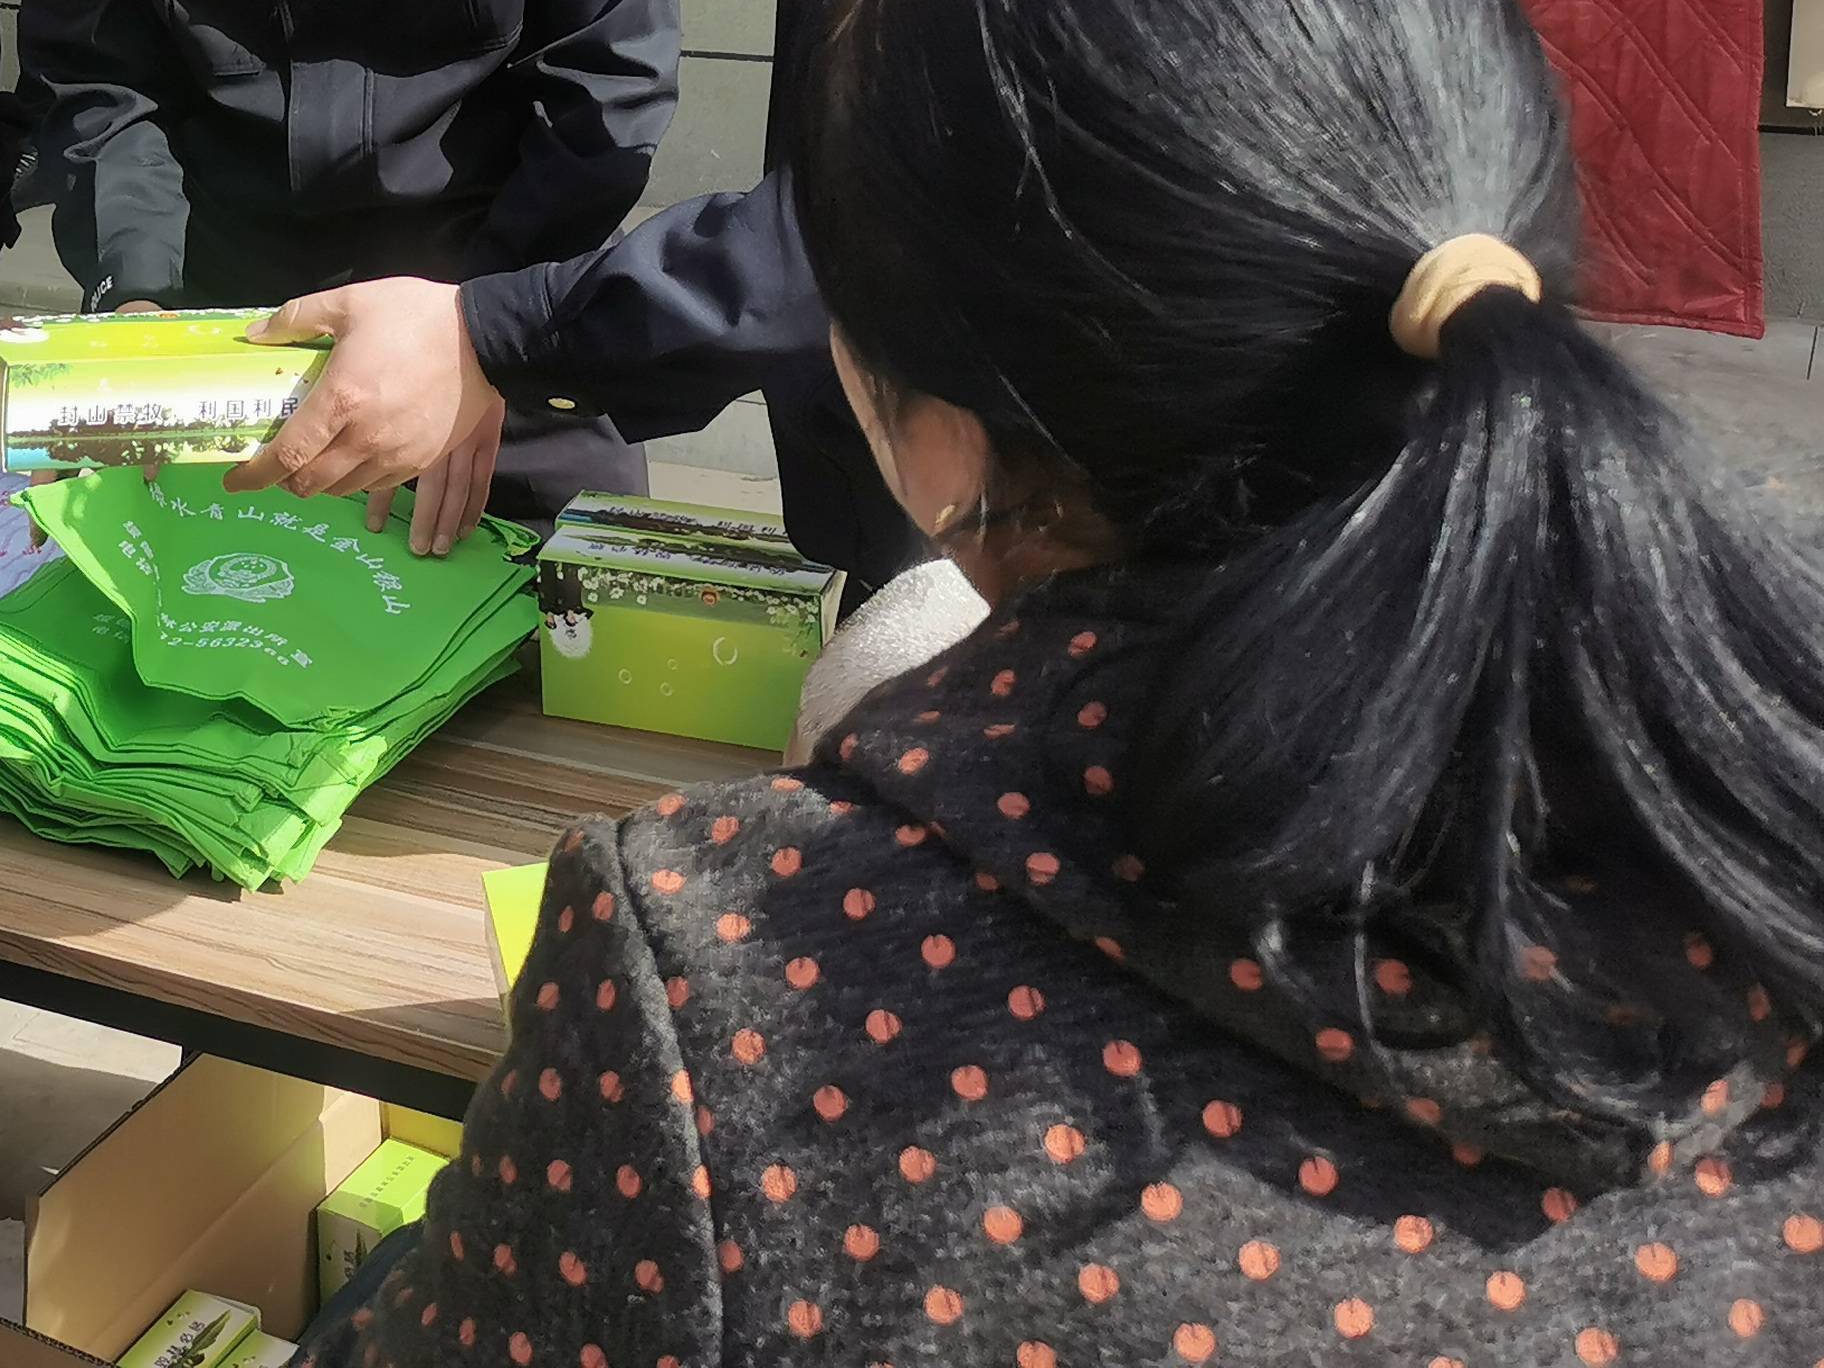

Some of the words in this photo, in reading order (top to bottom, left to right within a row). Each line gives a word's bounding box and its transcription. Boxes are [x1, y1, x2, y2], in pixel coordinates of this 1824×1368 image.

[60, 403, 165, 425] 封山禁牧
[198, 397, 299, 420] 利国利民
